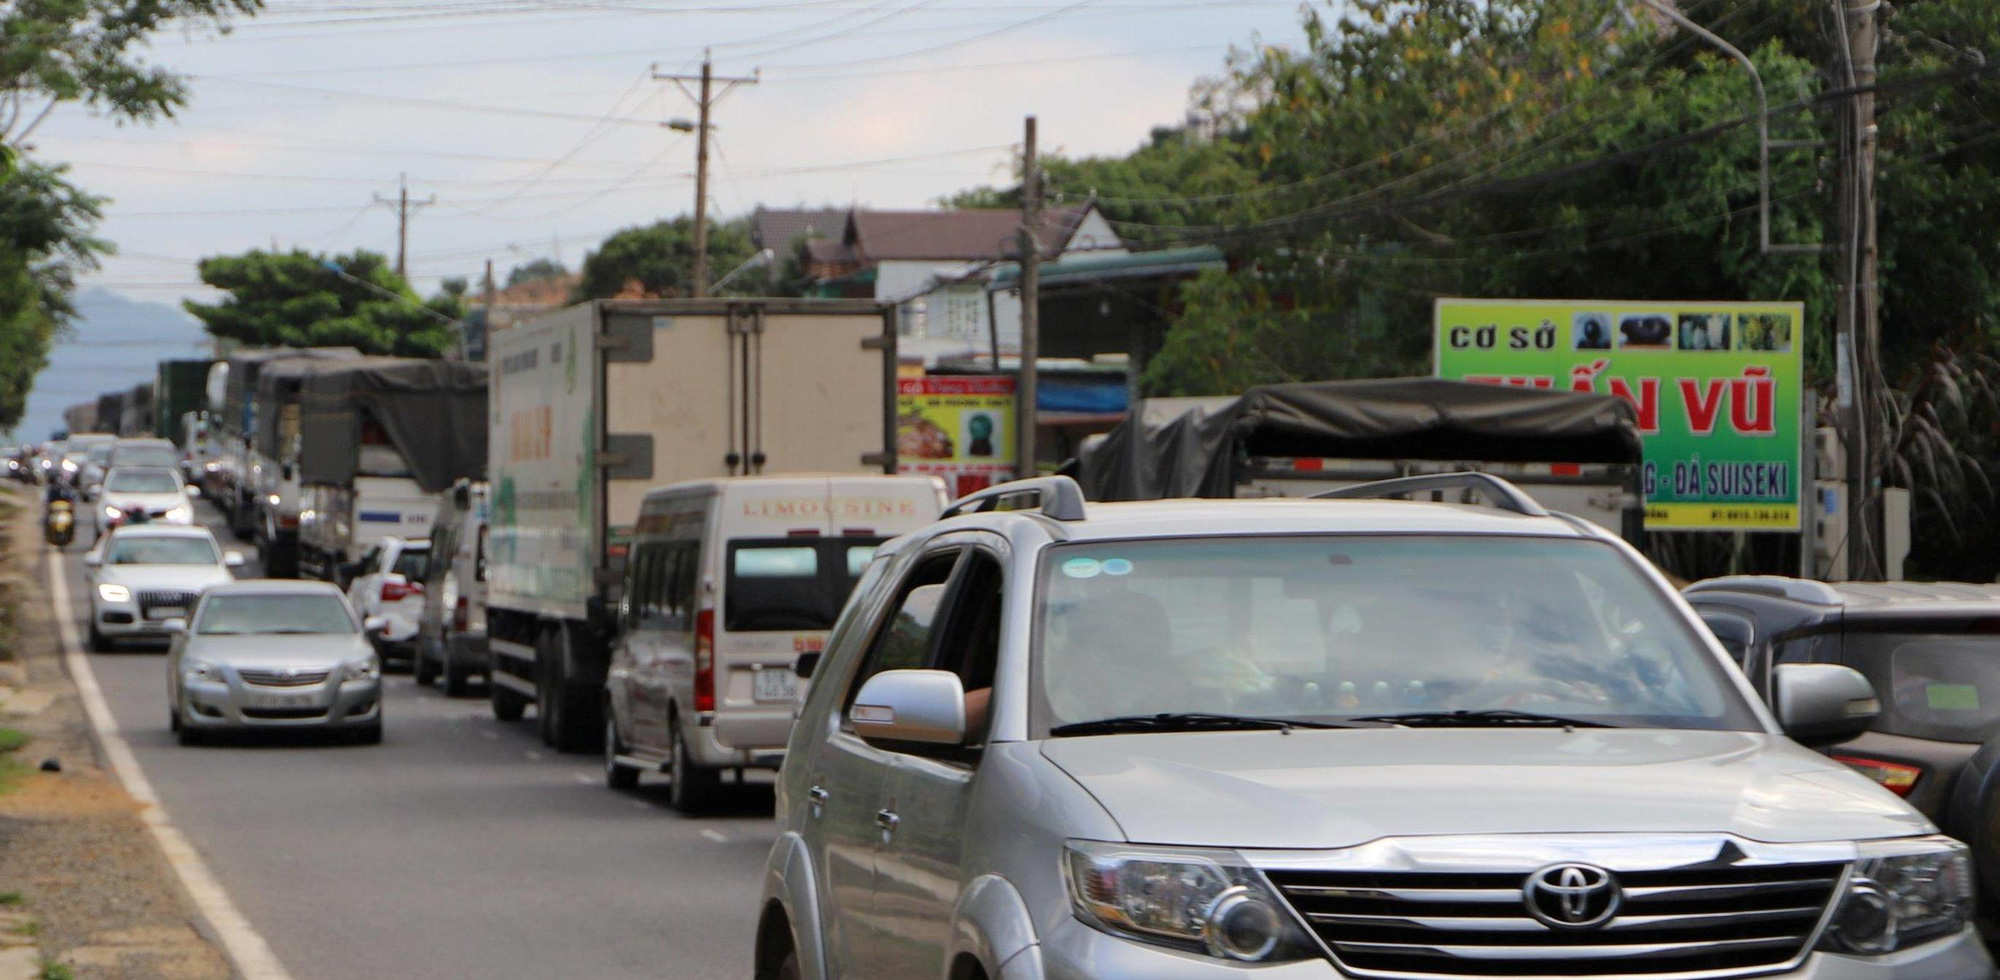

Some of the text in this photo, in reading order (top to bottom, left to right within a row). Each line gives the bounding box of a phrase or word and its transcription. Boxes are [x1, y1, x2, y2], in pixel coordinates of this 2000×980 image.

[1450, 319, 1555, 350] CƠ SỞ
[1677, 365, 1775, 434] VŨ
[1675, 453, 1701, 495] ĐÁ
[1707, 461, 1787, 496] SUISEKI
[743, 501, 915, 517] LIMOUSINE
